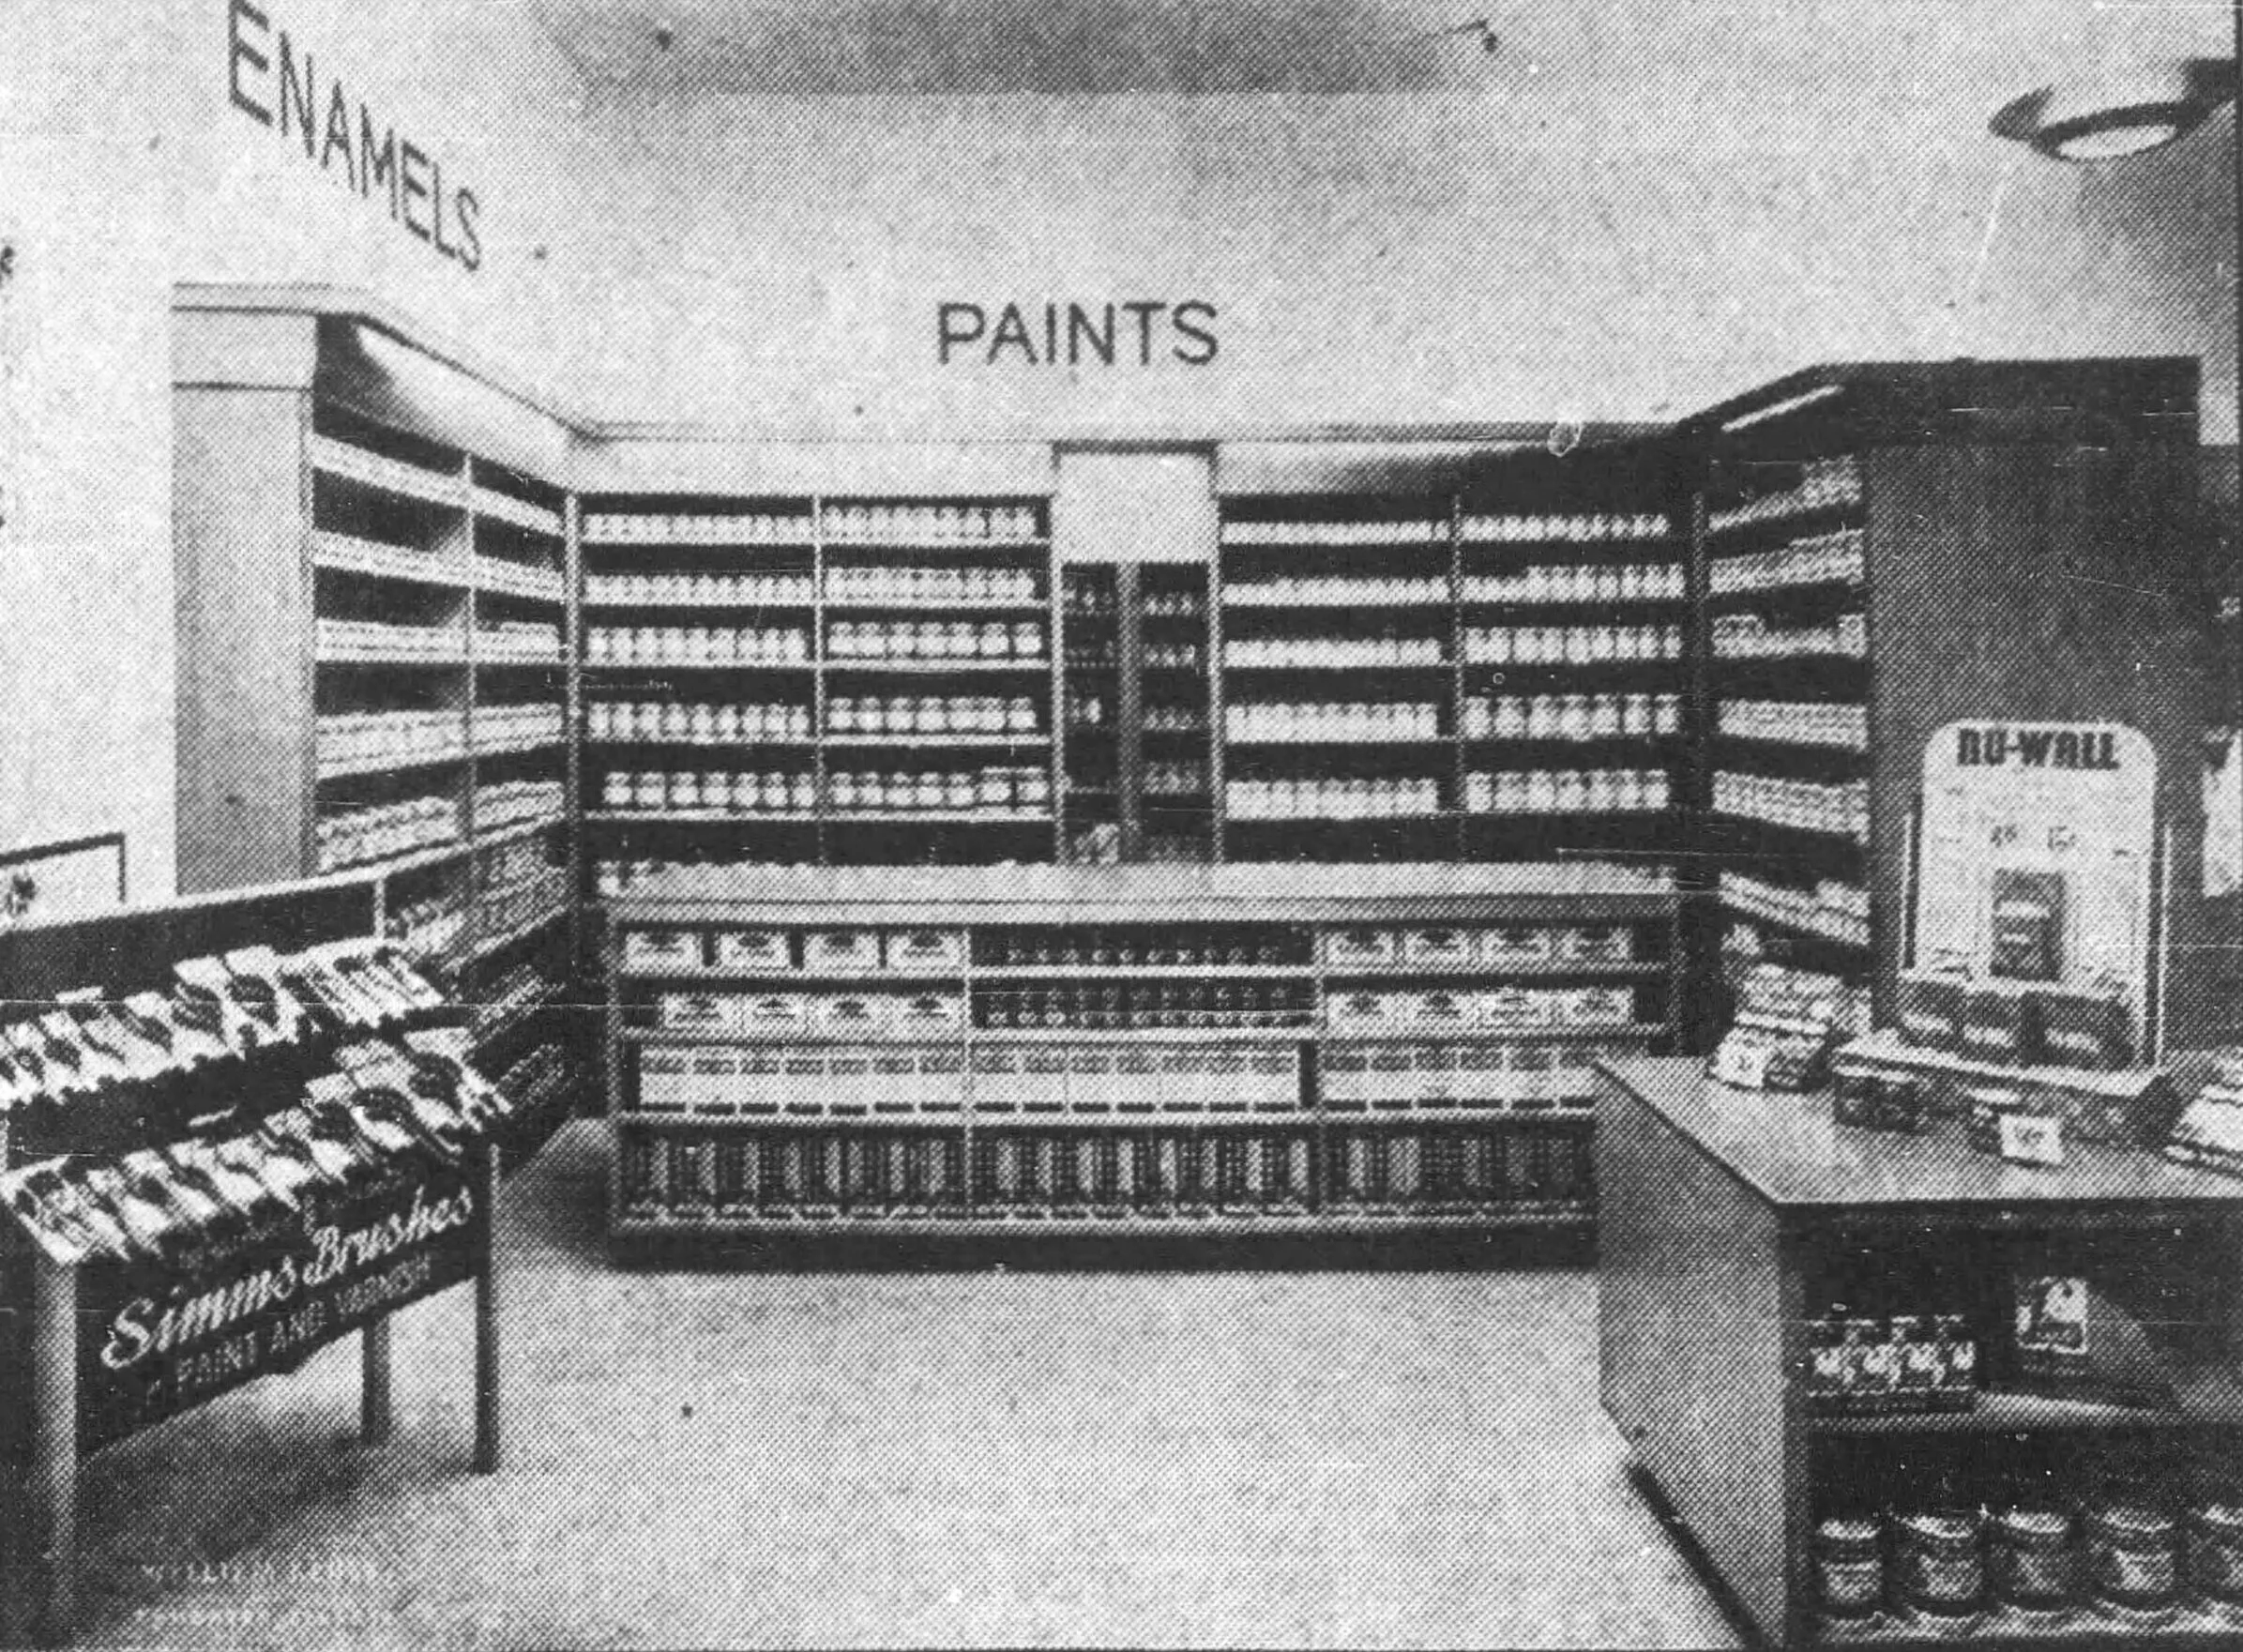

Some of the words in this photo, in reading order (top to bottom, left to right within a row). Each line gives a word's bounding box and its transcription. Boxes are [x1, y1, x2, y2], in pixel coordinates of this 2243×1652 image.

[228, 0, 481, 272] ENAMELS
[938, 299, 1219, 366] PAINTS
[100, 1256, 296, 1369] Simms
[302, 1185, 472, 1287] Brushes
